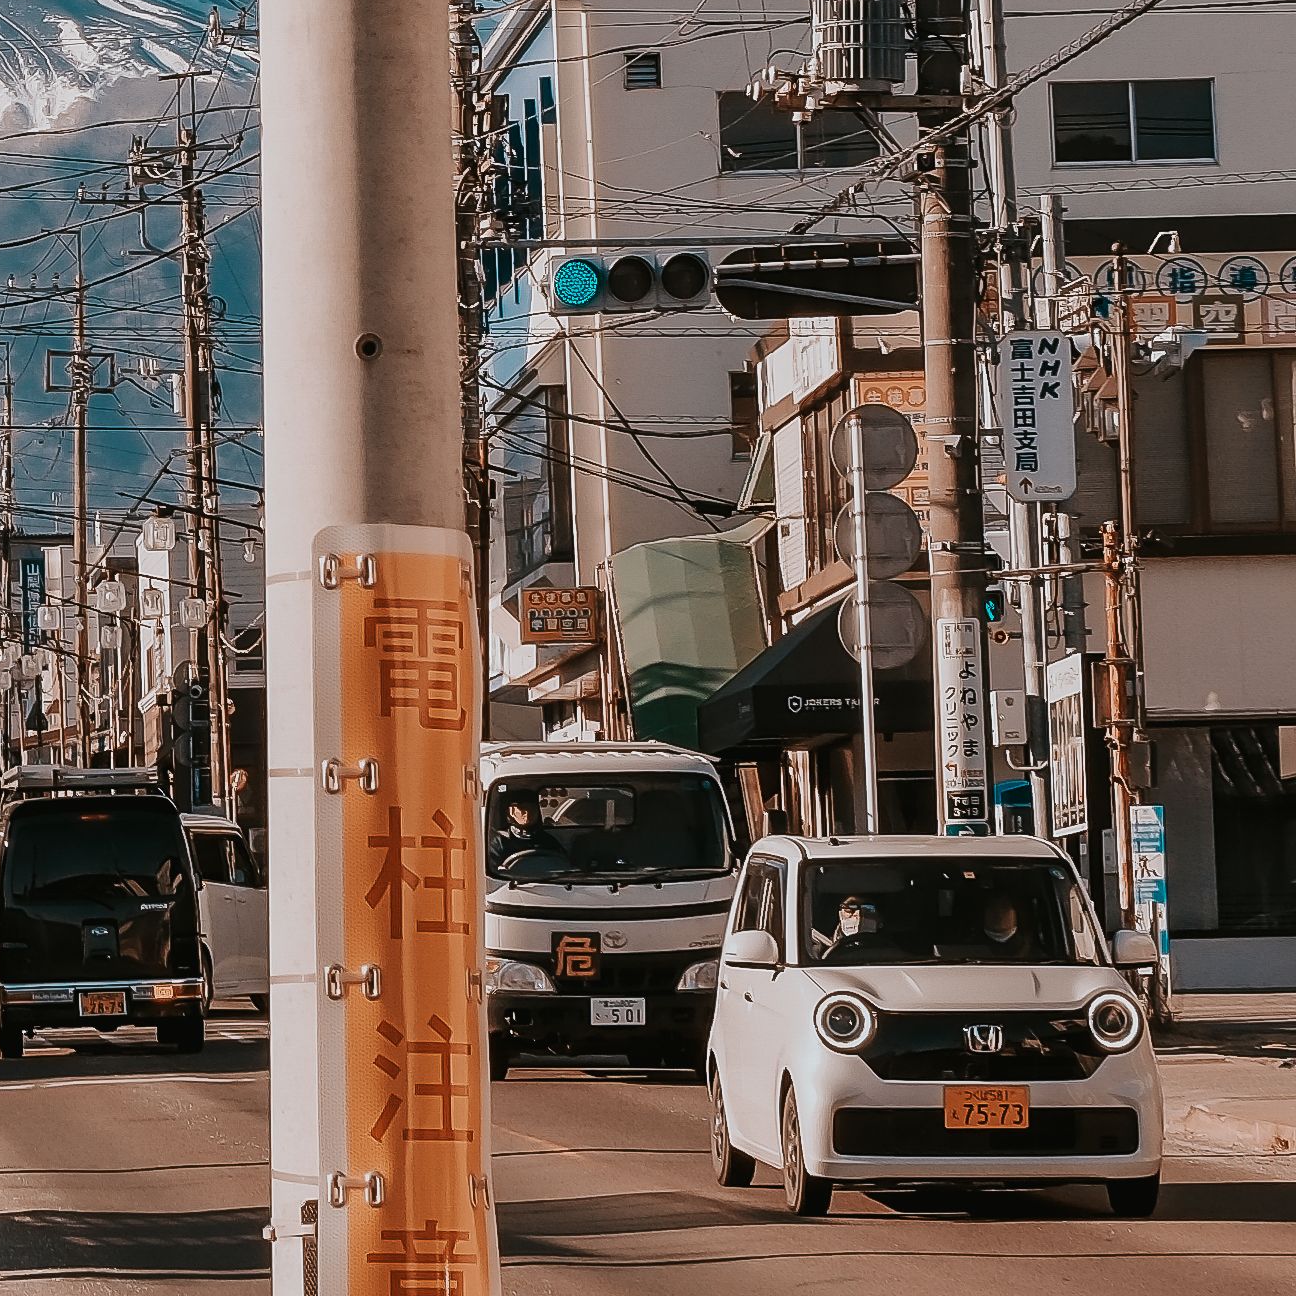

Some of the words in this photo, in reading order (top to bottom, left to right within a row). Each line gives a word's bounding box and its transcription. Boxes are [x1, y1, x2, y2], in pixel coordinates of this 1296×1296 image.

[1038, 337, 1061, 399] NHK
[1010, 338, 1039, 472] 富士吉田支局
[944, 687, 959, 757] クリニック
[958, 661, 979, 757] よねやま
[556, 935, 596, 976] 危
